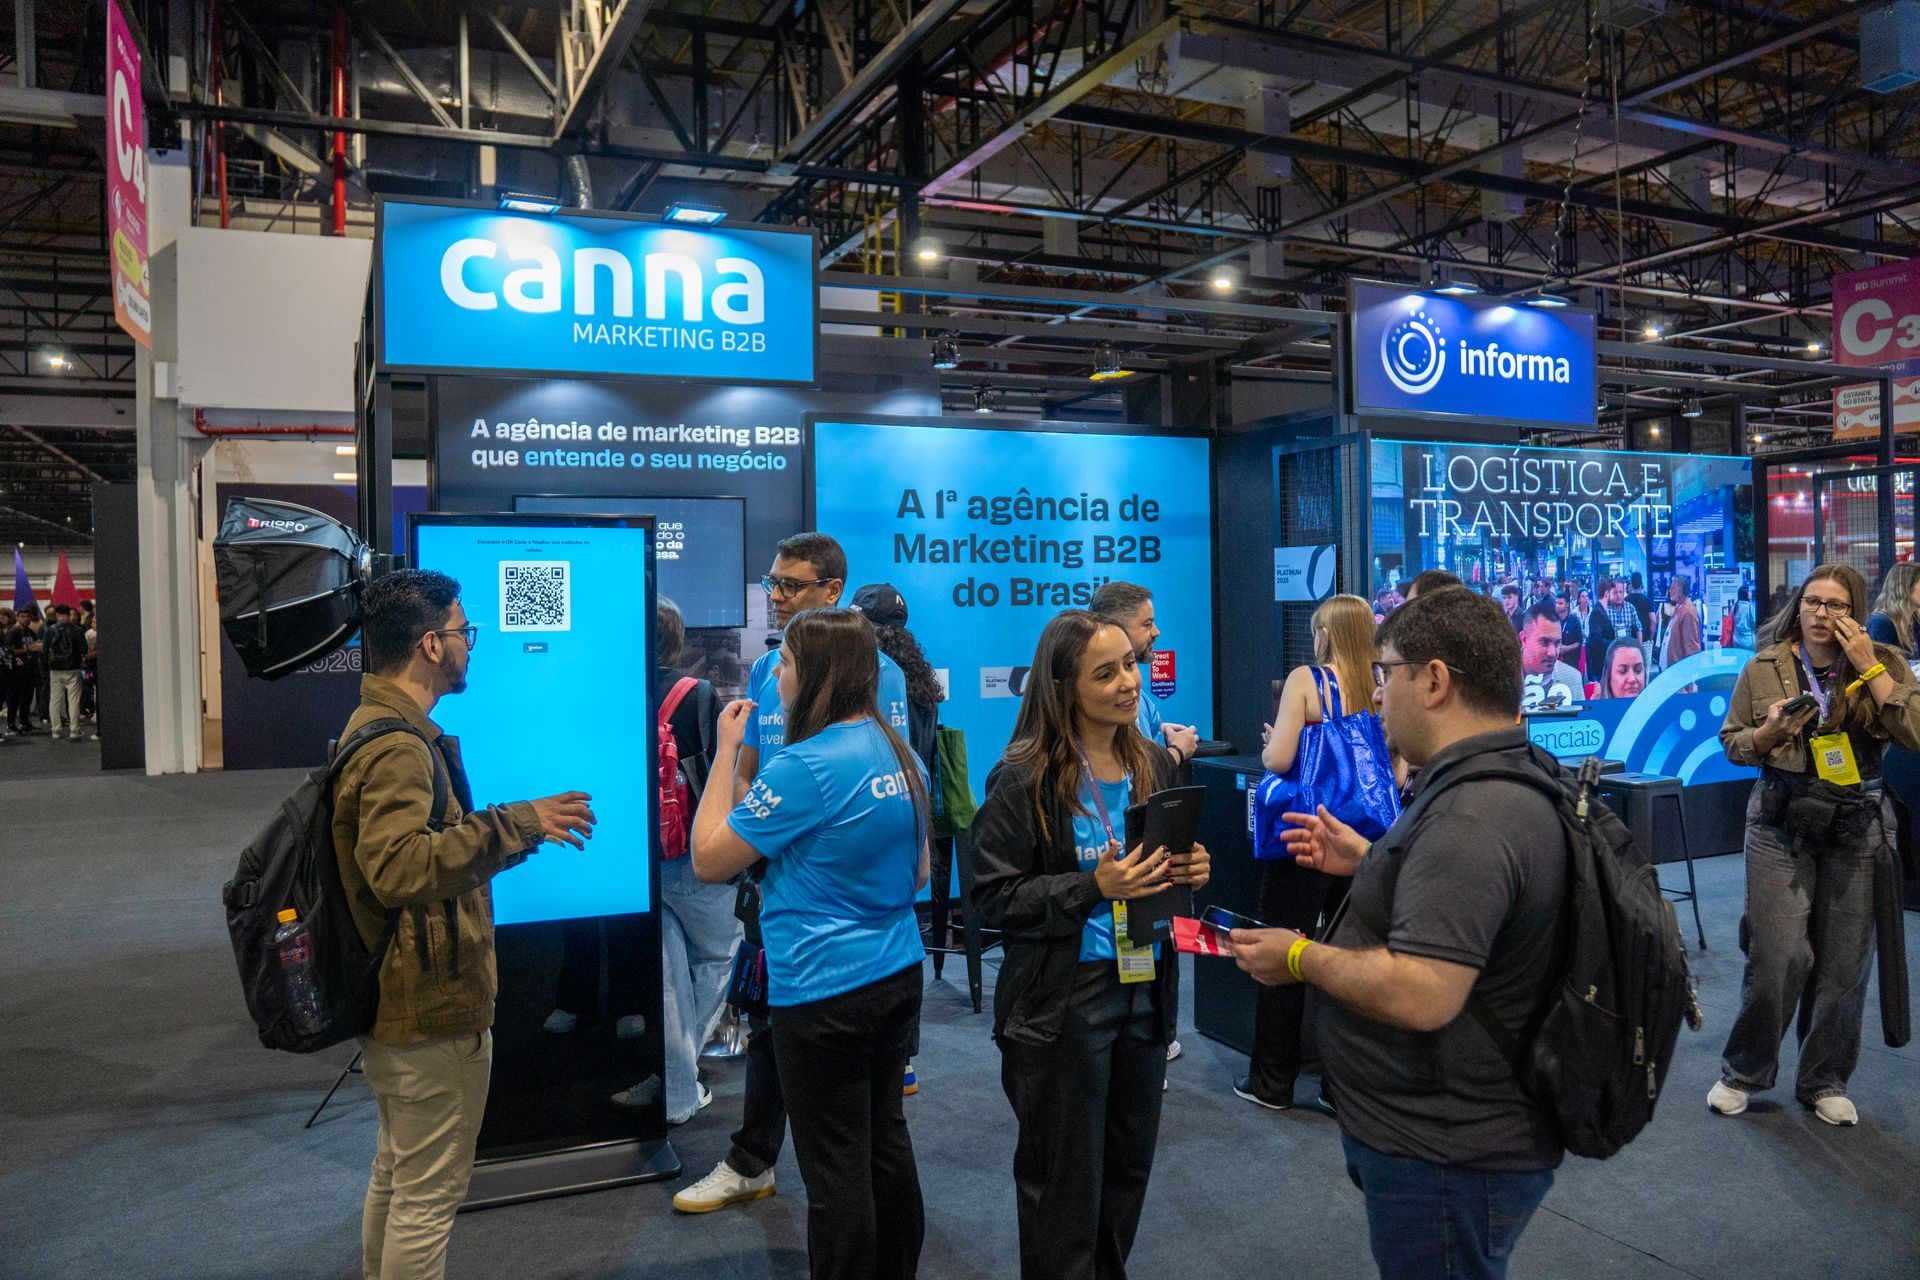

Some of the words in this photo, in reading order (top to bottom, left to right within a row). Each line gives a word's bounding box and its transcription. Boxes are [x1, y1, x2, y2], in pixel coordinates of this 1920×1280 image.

[440, 236, 766, 326] canna
[1855, 282, 1869, 292] RD
[1870, 273, 1907, 289] Summit
[573, 322, 714, 351] MARKETING
[722, 330, 766, 353] B2B
[1459, 338, 1570, 384] informa
[1843, 390, 1872, 399] ESTANDE
[471, 418, 490, 438] A
[495, 417, 592, 442] agência
[597, 421, 627, 441] de
[632, 424, 751, 447] marketing
[755, 426, 800, 446] B2B
[471, 449, 519, 469] que
[524, 448, 625, 467] entende
[630, 452, 645, 468] o
[650, 452, 692, 468] seu
[697, 450, 787, 472] negócio
[1422, 447, 1632, 497] LOGÍSTICA
[1641, 463, 1662, 498] E
[896, 488, 925, 519] A
[967, 486, 1110, 526] agência
[1119, 493, 1160, 523] de
[1410, 499, 1672, 539] TRANSPORTE
[247, 517, 305, 532] TRIOPO
[658, 522, 683, 531] que
[675, 531, 685, 540] o
[666, 540, 683, 550] da
[894, 533, 1084, 569] Marketing
[1093, 534, 1162, 564] B2B
[952, 577, 1000, 608] do
[1010, 576, 1110, 607] Brasi
